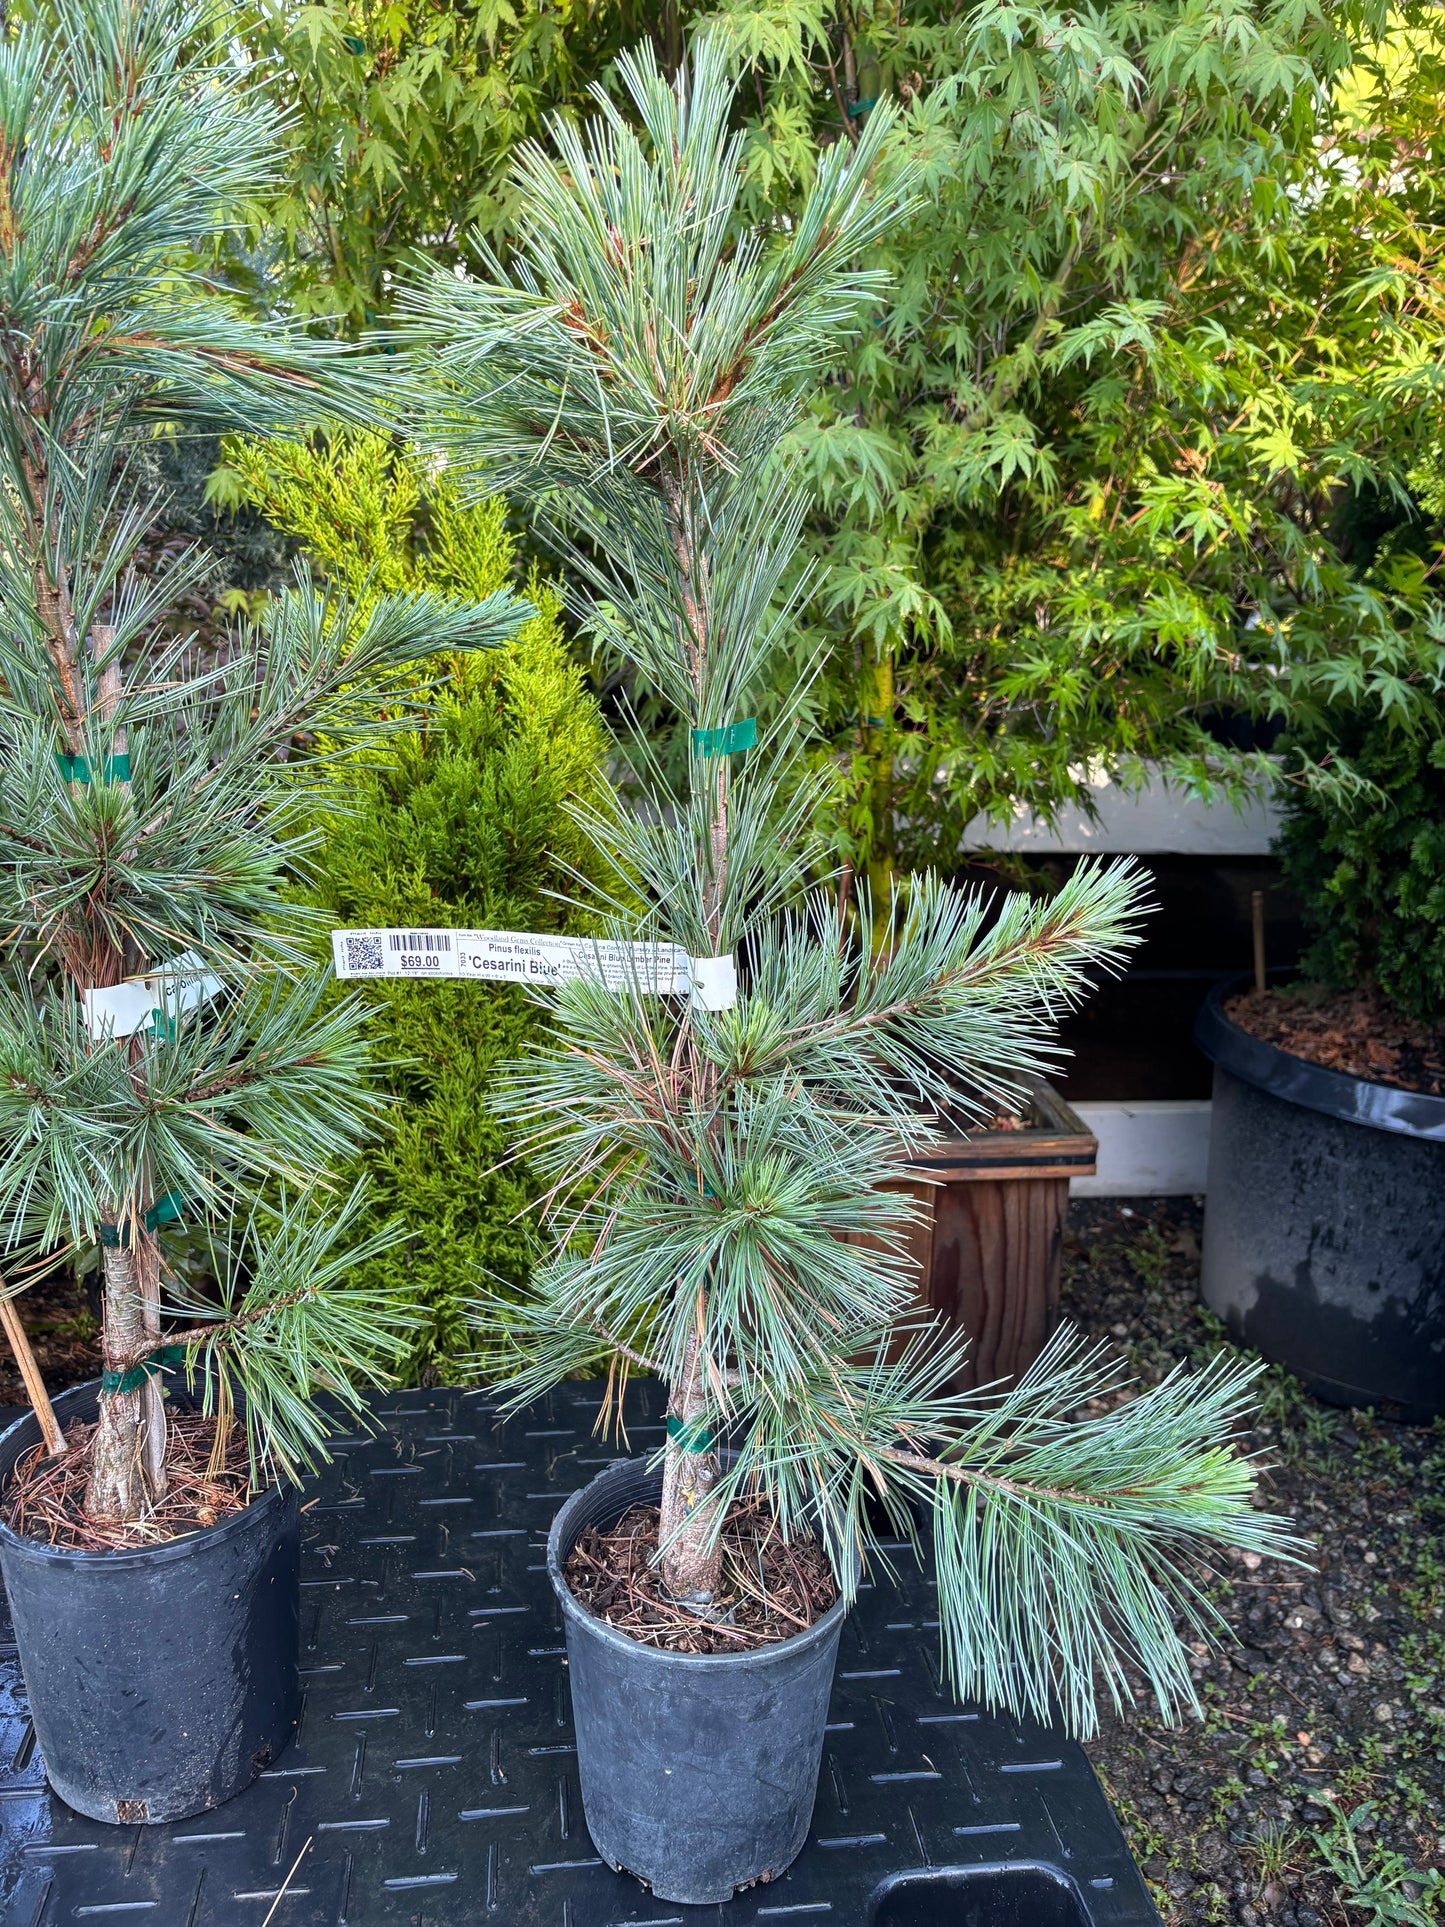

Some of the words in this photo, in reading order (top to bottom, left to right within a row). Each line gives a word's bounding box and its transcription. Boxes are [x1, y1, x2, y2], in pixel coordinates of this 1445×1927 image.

[488, 943, 512, 954] Pinus
[514, 945, 541, 956] flexilis
[400, 955, 440, 968] $69.00
[468, 955, 526, 973] 'Cesarini
